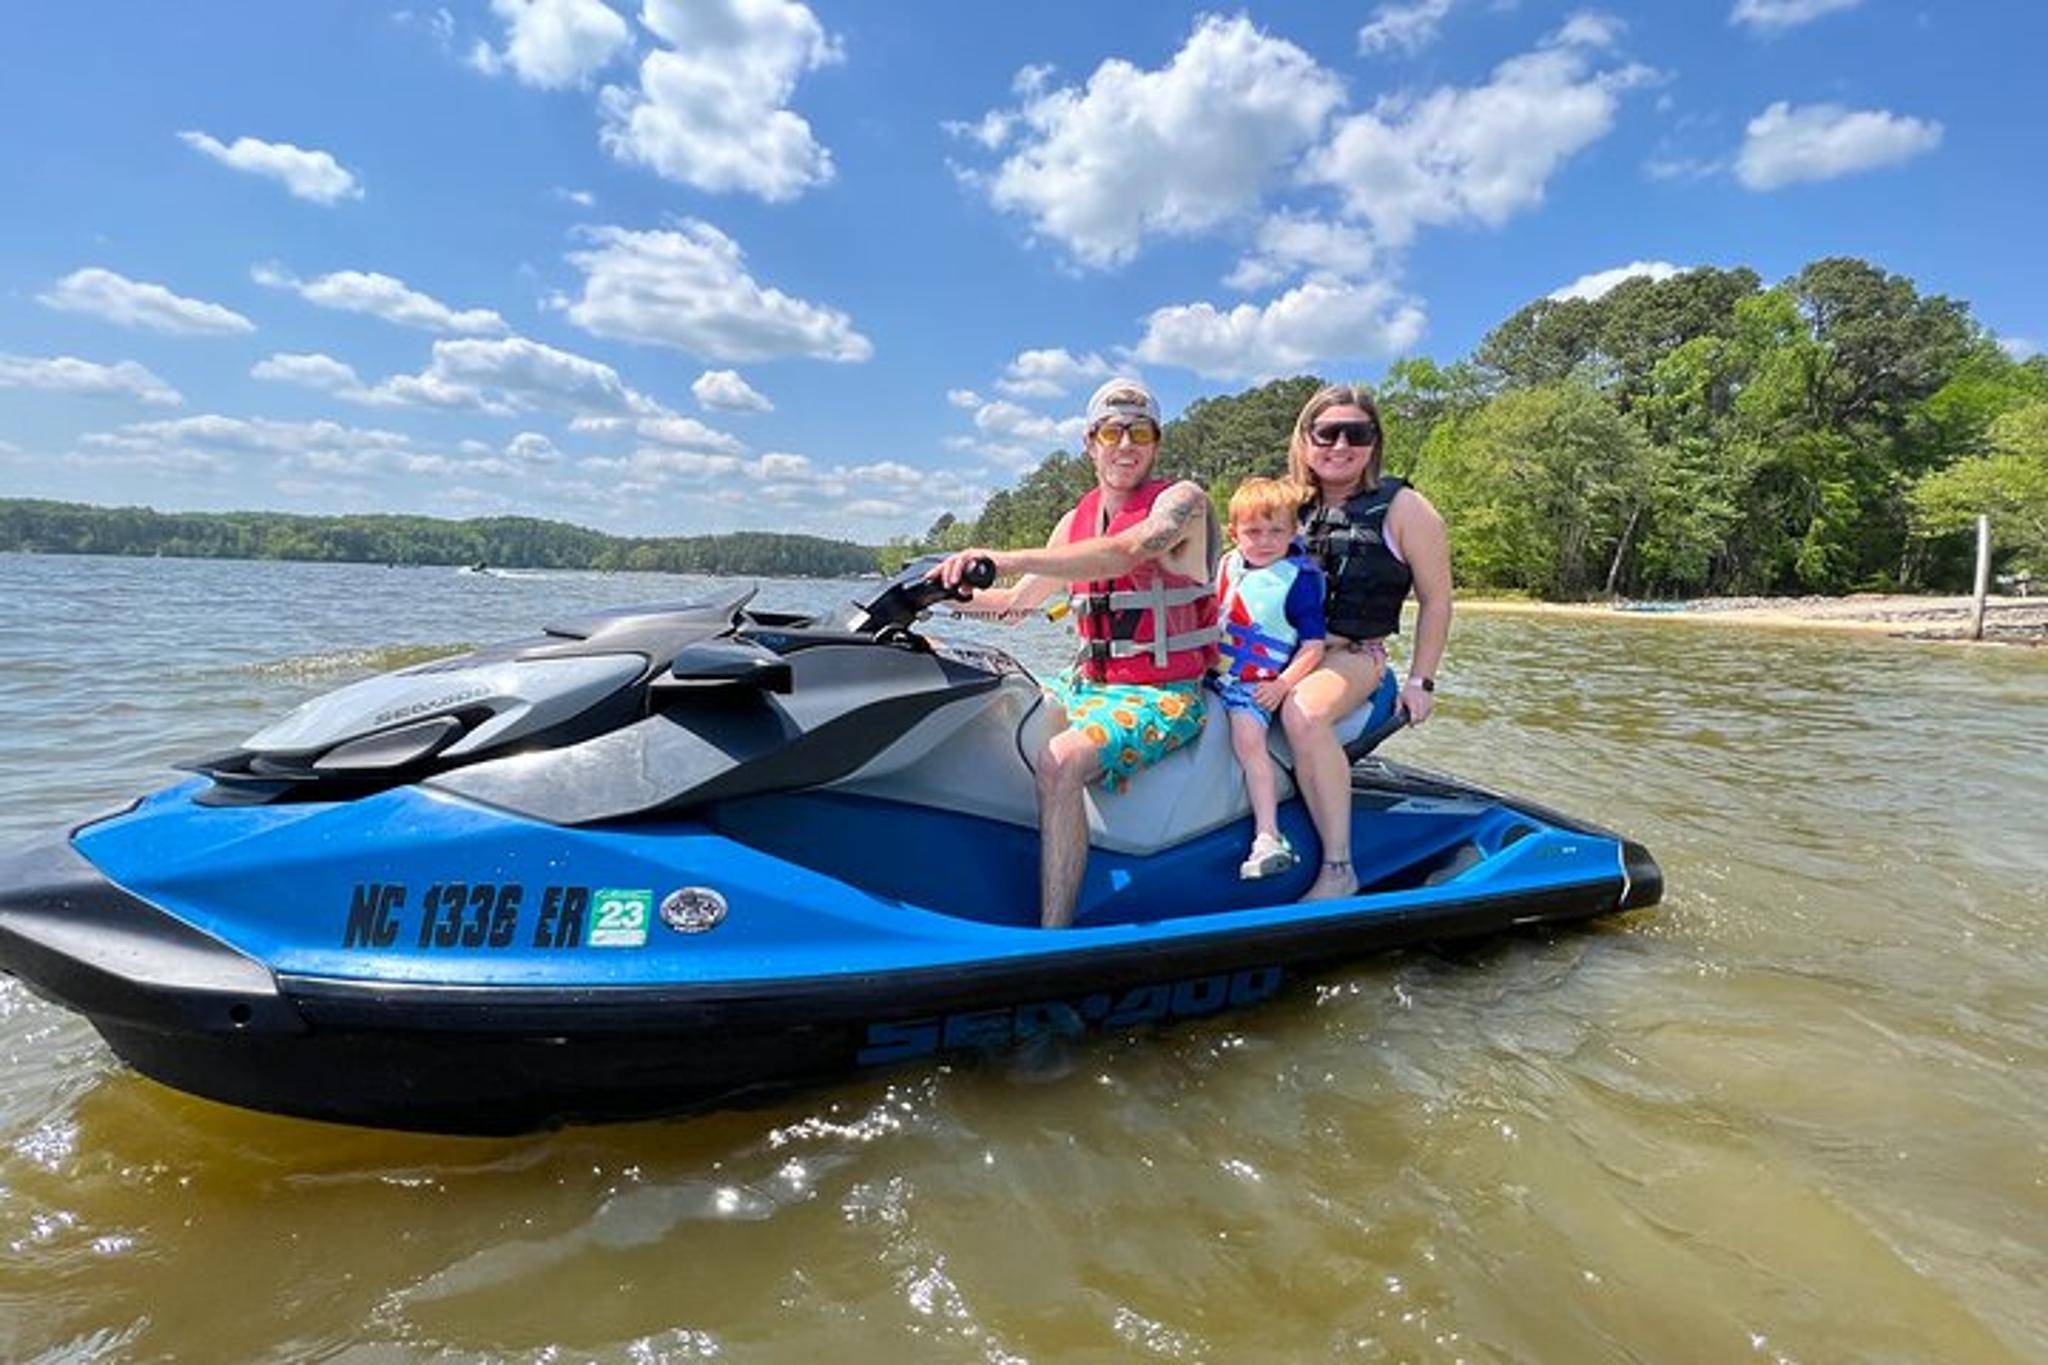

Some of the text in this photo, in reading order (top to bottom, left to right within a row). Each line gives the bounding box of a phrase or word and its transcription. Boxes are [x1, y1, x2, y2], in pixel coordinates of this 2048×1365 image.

[343, 884, 406, 949] NC
[418, 884, 523, 948] 1336
[533, 887, 589, 948] ER
[599, 900, 644, 928] 23
